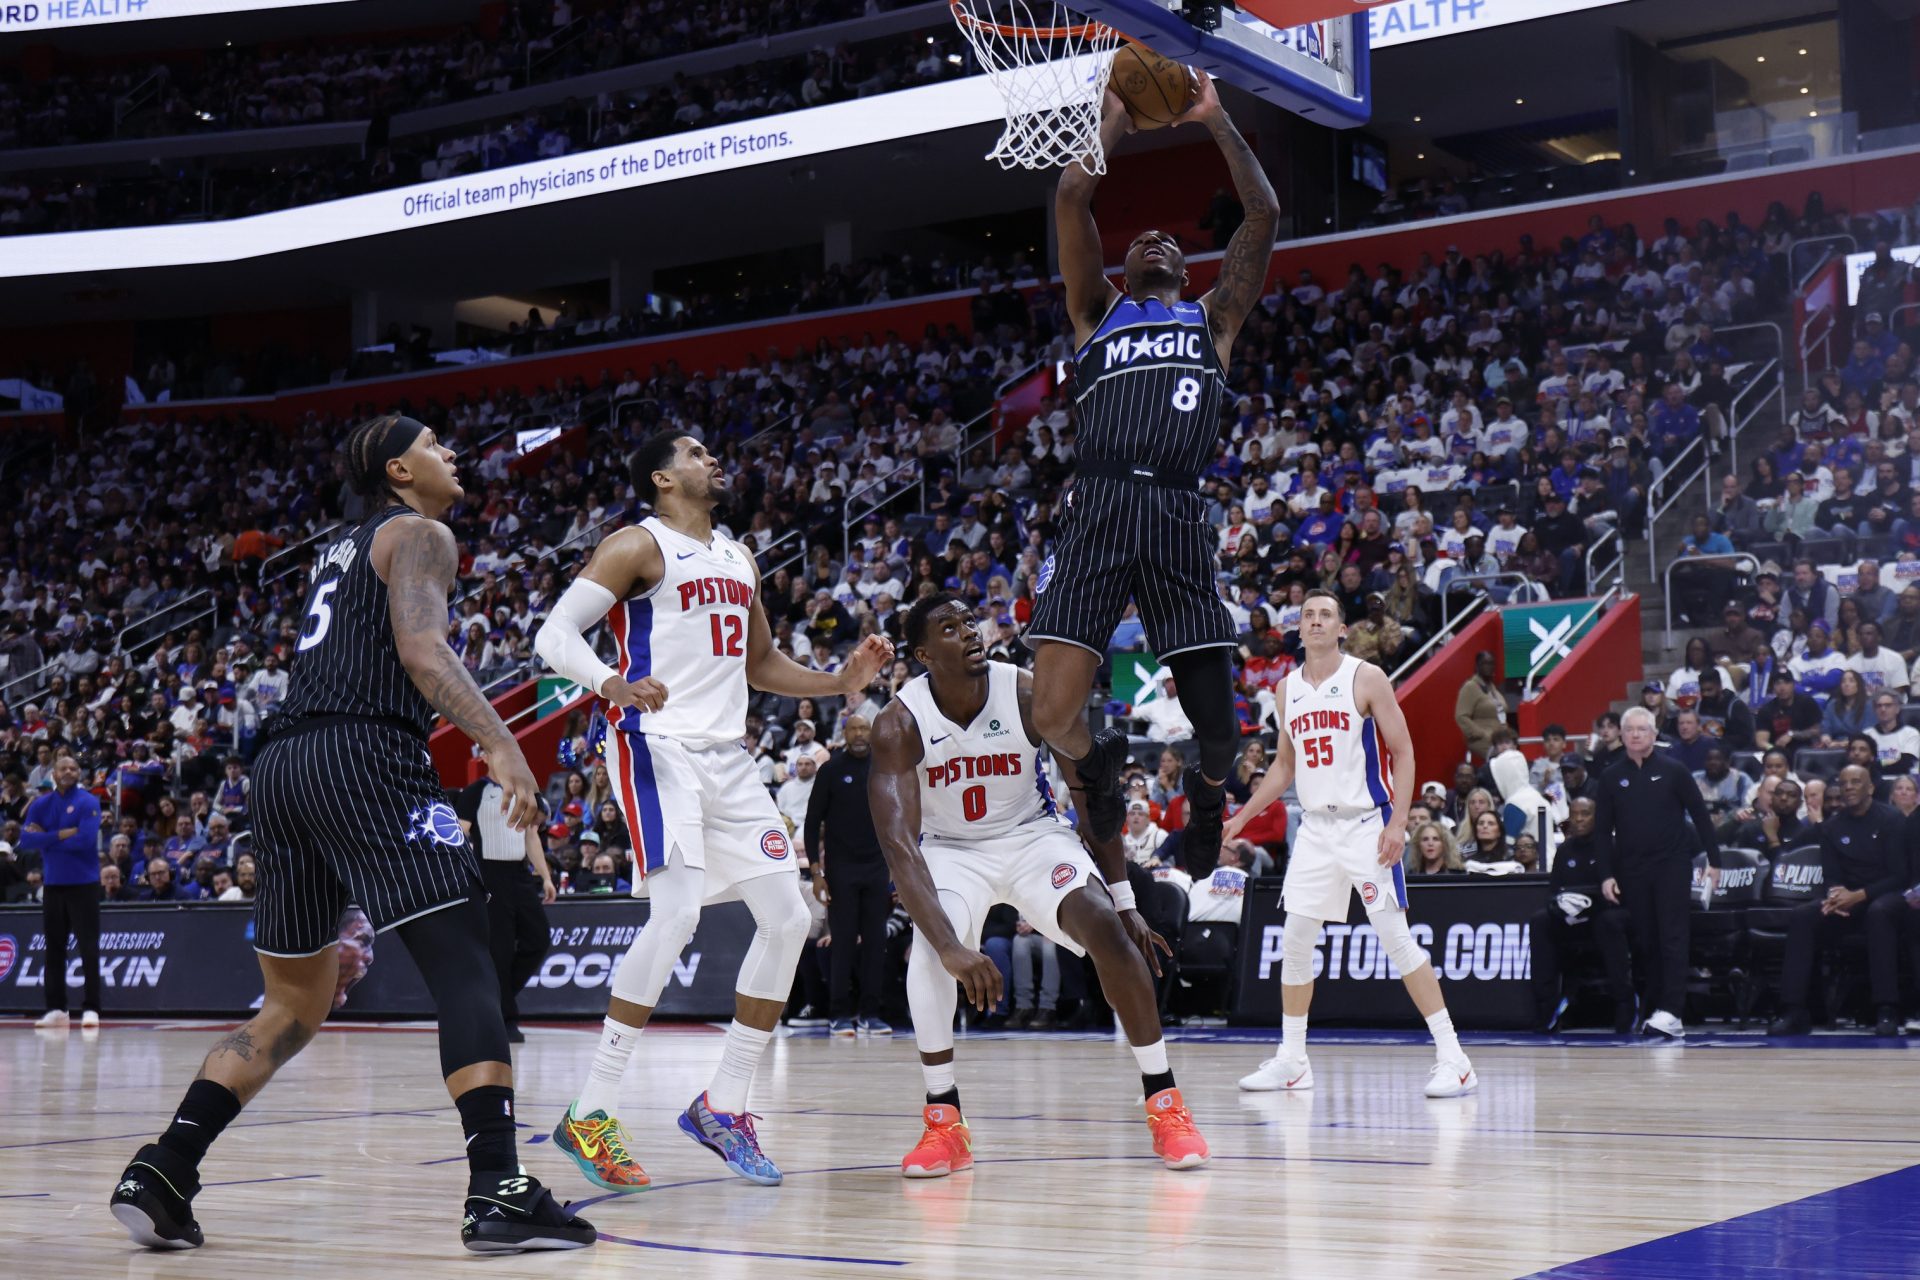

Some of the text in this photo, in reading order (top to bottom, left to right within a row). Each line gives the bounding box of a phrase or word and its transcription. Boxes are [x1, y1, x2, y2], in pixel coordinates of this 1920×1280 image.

[0, 4, 39, 24] RD
[1369, 0, 1485, 38] EALTH
[403, 131, 793, 217] Official team physicians of the Detroit Pistons.
[1172, 376, 1201, 412] 8
[295, 577, 338, 652] 5
[710, 613, 743, 657] 12
[1289, 710, 1350, 739] PISTONS
[1303, 736, 1334, 768] 55
[926, 753, 1022, 788] PISTONS
[962, 785, 988, 822] 0
